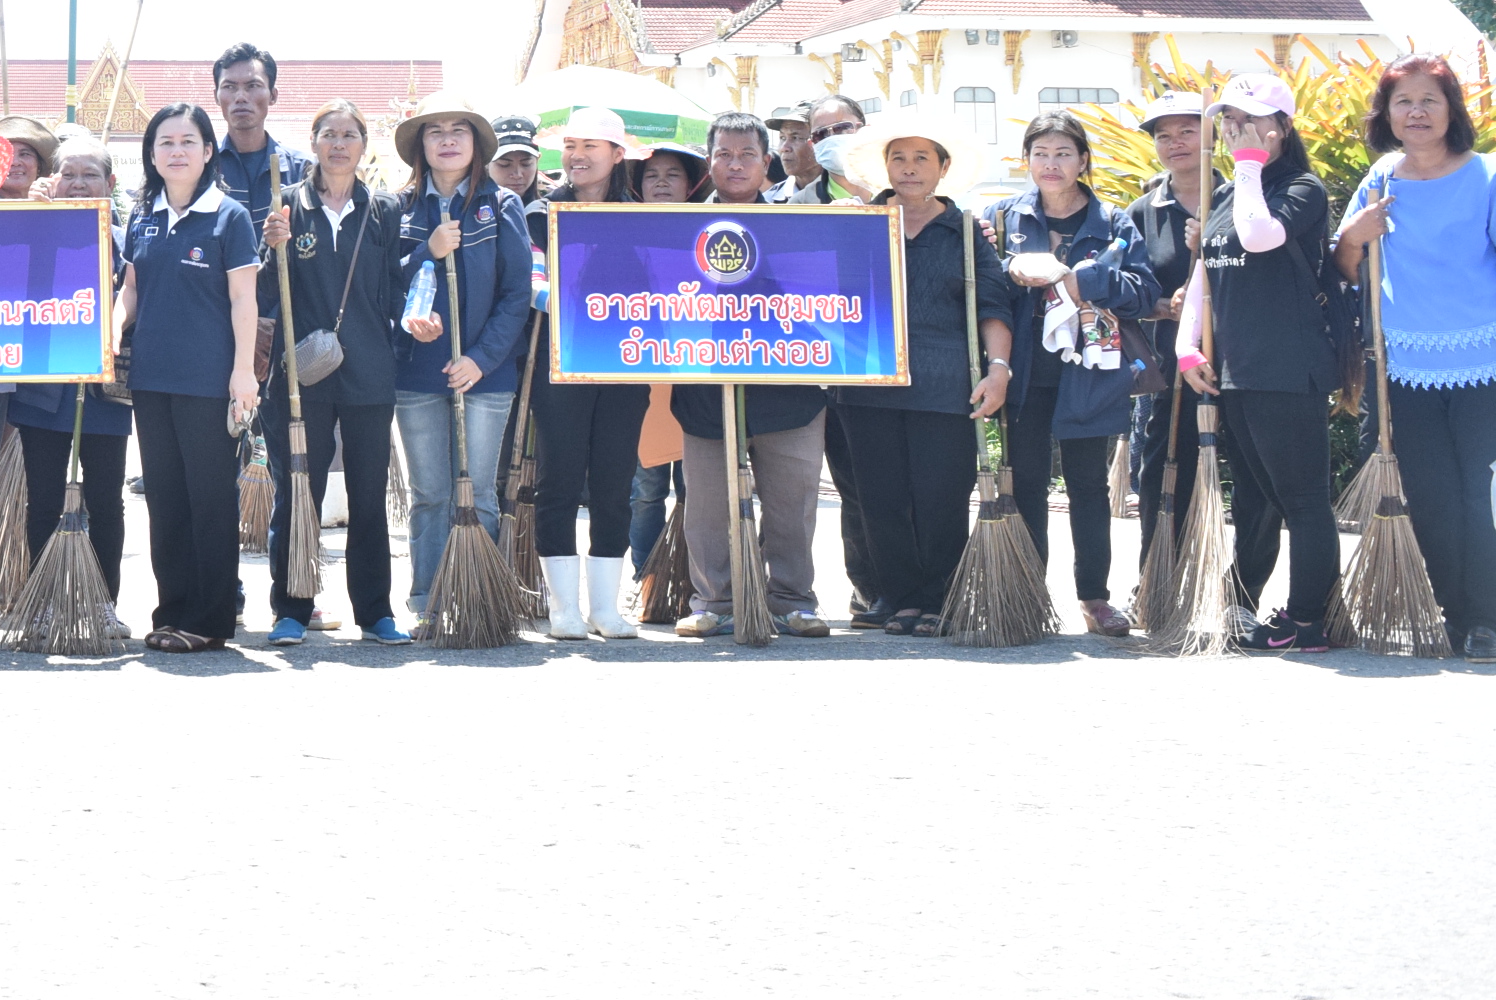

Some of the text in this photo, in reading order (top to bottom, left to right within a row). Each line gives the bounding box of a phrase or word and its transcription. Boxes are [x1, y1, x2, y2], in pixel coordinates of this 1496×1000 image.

[586, 281, 862, 333] อาสาพัฒนาชุมชน
[620, 327, 832, 367] อำเภอเต่างอย
